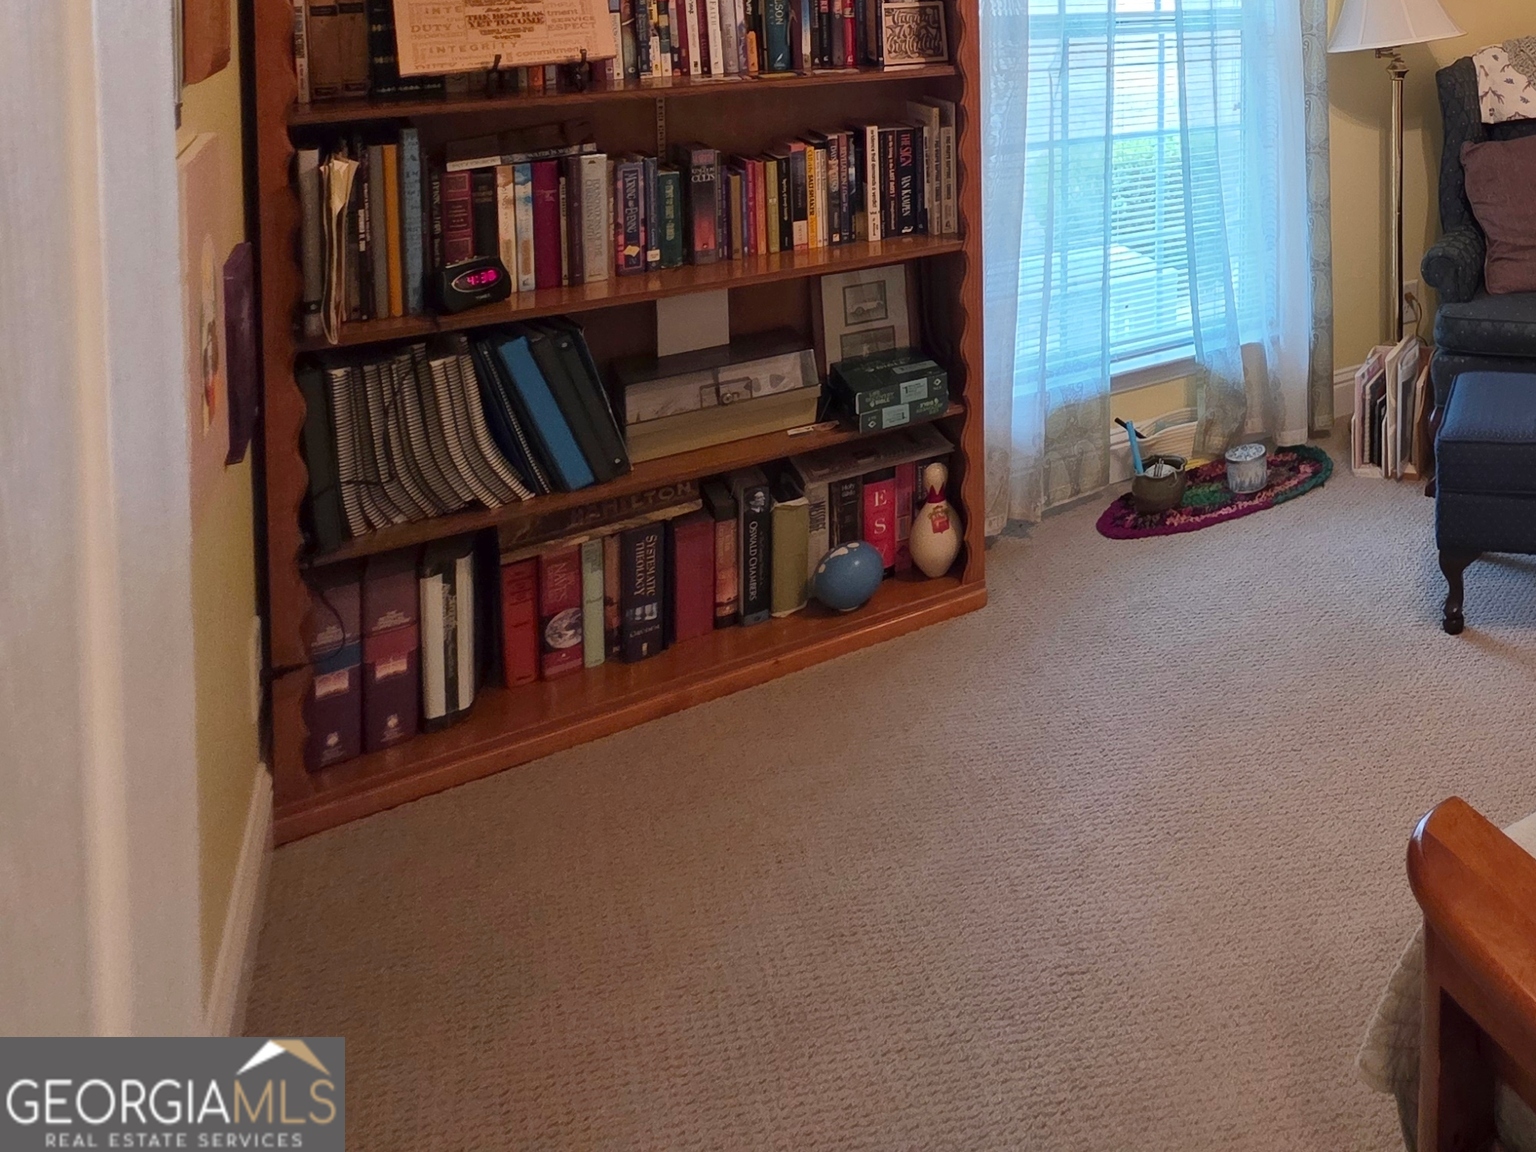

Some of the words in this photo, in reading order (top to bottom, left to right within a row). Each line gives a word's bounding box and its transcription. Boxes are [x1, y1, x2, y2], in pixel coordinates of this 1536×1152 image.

[710, 0, 718, 27] FAITH
[411, 23, 452, 34] DUTY
[428, 42, 517, 55] INTEGRITY
[900, 133, 911, 146] THE
[900, 146, 912, 167] SIGN
[901, 189, 912, 217] KAMPEN
[748, 520, 758, 556] OSWALD
[633, 541, 645, 596] THEOLOGY
[645, 534, 658, 597] SYSTEMATIC
[748, 556, 758, 601] CHAMBERS
